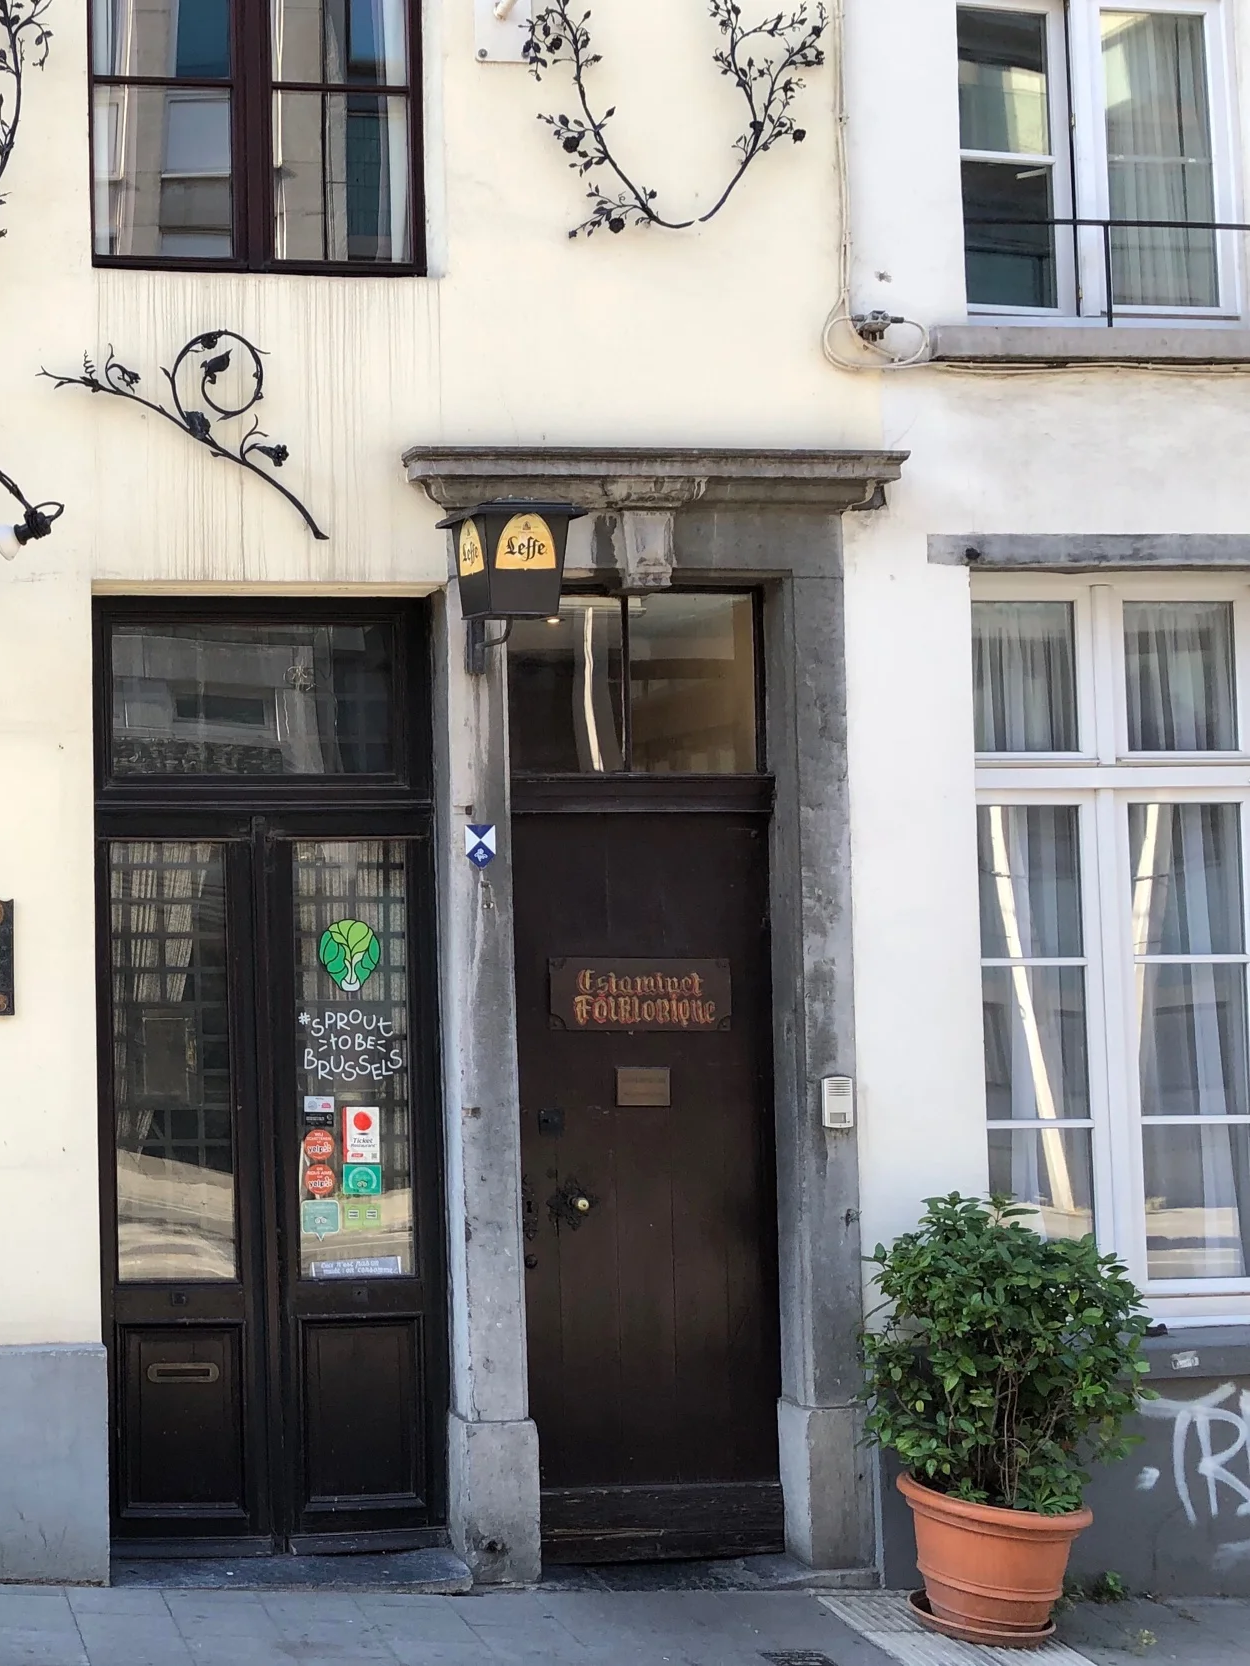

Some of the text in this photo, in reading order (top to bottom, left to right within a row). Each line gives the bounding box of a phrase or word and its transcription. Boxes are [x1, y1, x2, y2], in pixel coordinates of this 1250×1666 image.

[462, 541, 479, 567] Leffe
[504, 536, 547, 562] Leffe
[576, 968, 703, 997] Estaminet
[355, 1033, 376, 1050] BE
[304, 1048, 402, 1082] BRUSSELS
